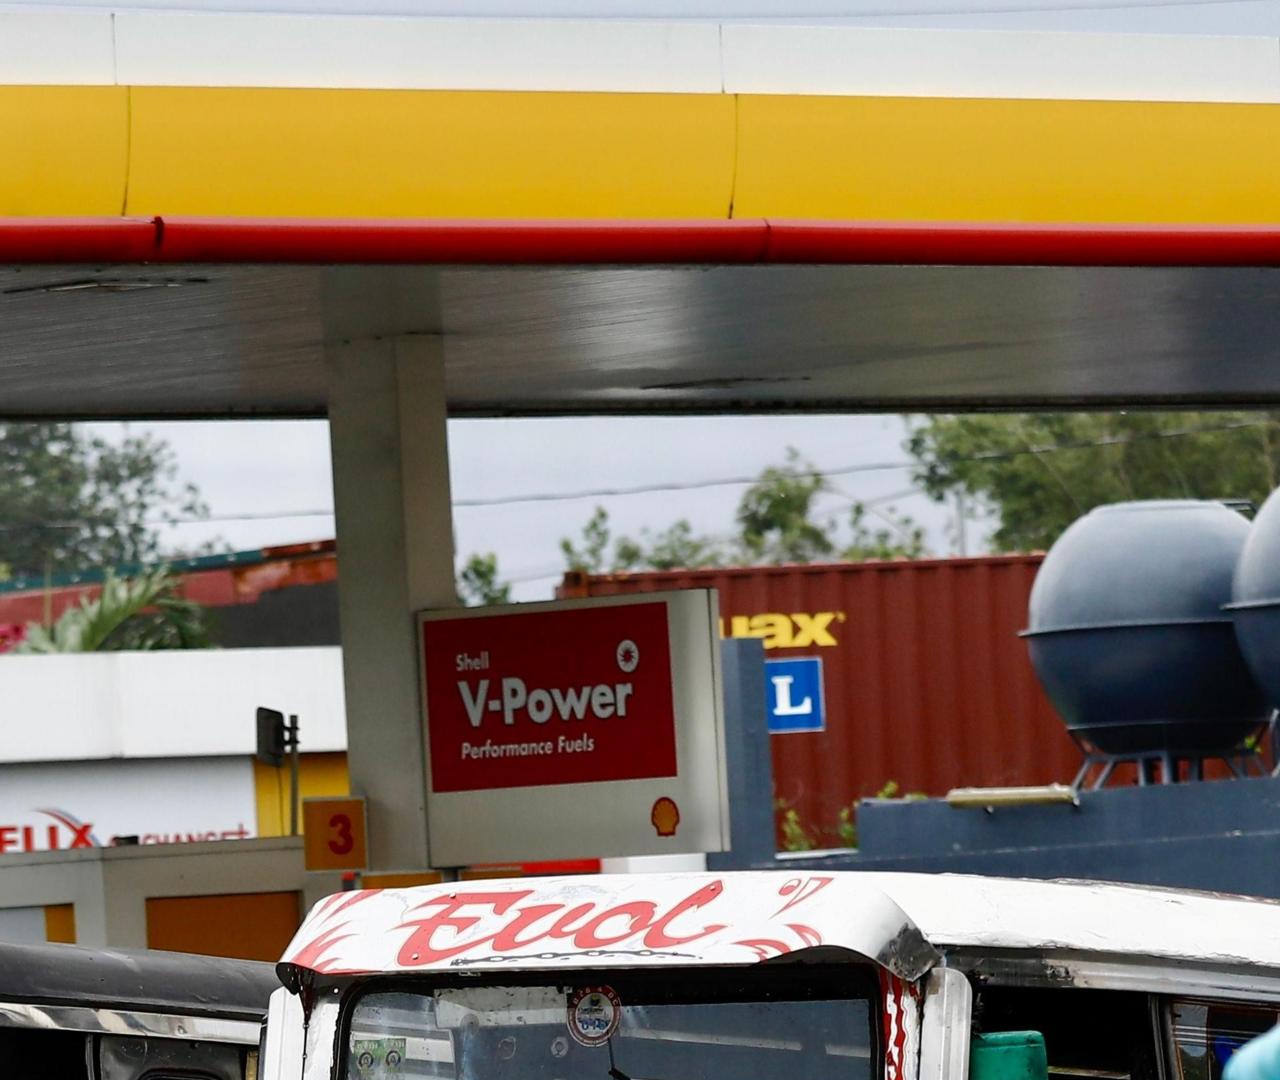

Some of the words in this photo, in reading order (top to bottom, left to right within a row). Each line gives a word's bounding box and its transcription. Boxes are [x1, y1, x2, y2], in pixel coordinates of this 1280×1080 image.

[456, 651, 489, 672] Shell
[457, 676, 633, 728] V-Power
[461, 739, 554, 761] Performance
[557, 732, 595, 754] Fuels
[327, 813, 354, 856] 3
